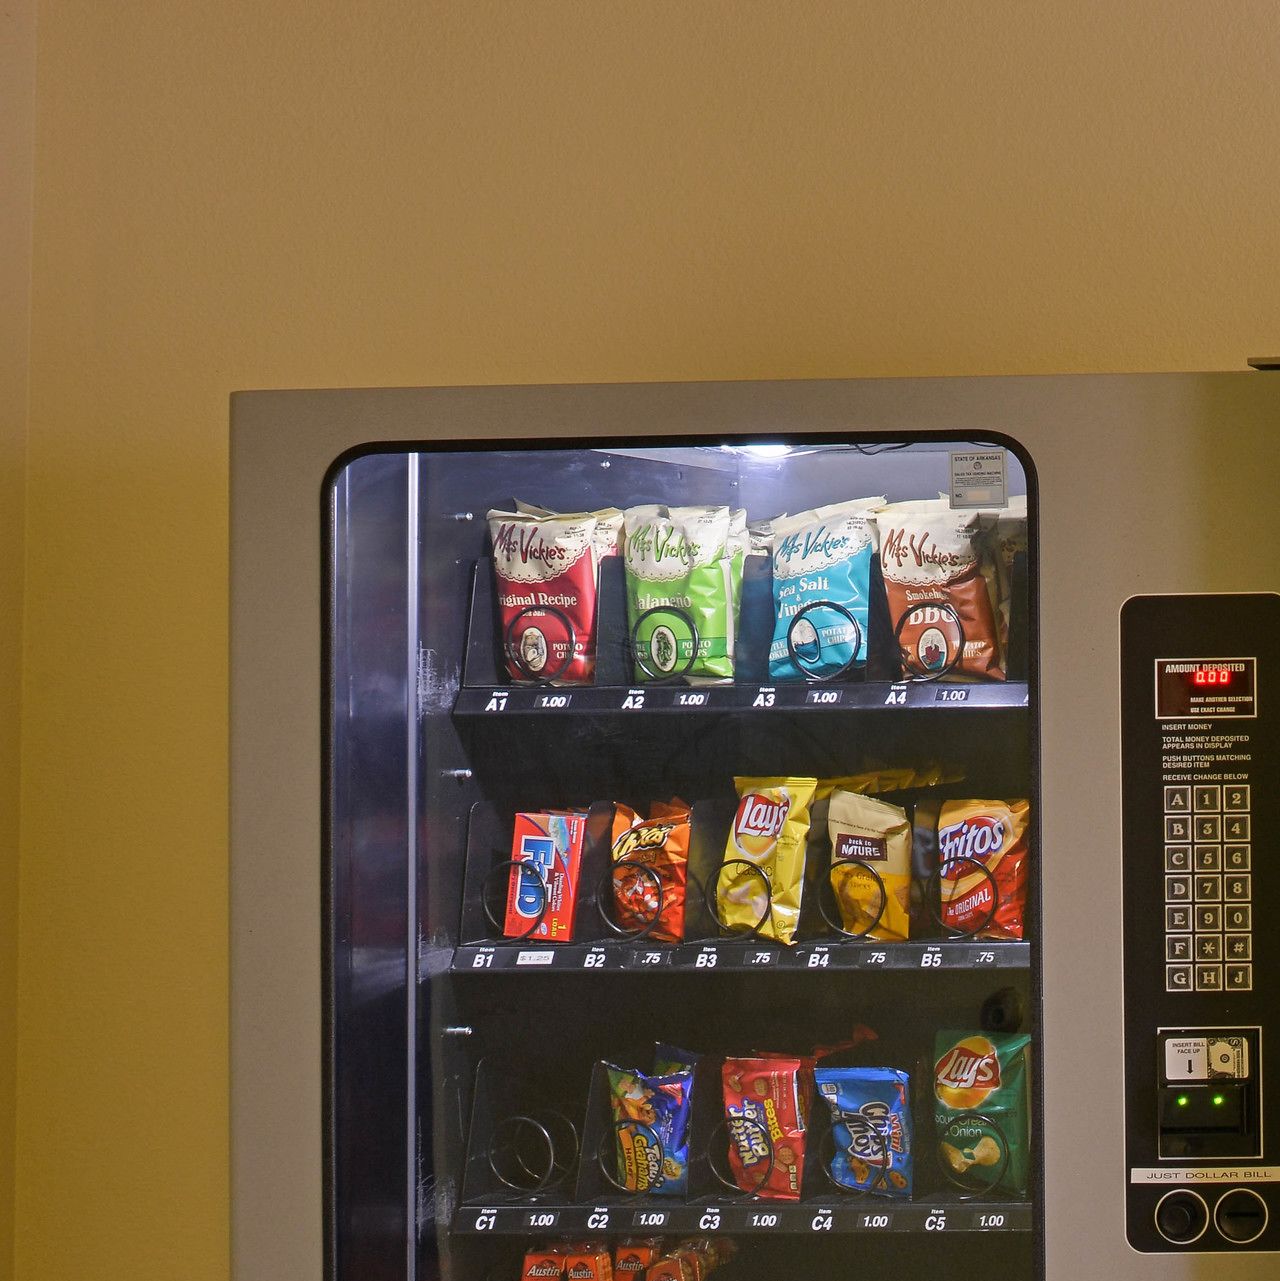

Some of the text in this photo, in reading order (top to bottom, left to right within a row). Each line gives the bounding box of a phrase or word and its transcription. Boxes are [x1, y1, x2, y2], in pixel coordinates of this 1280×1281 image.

[520, 527, 566, 567] Vickie's
[802, 526, 850, 563] Vickie's
[910, 532, 960, 573] Vickie's
[799, 577, 829, 592] Salt
[1165, 663, 1245, 674] AMOUNT DEPOSITED
[622, 693, 644, 709] A2
[680, 695, 704, 705] 1.00
[753, 691, 775, 706] A3
[813, 692, 837, 702] 1.00
[885, 690, 906, 704] A4
[941, 689, 966, 701] 1.00
[485, 695, 508, 711] A1
[542, 697, 566, 707] 1.00
[940, 821, 1004, 877] Fritos
[955, 888, 991, 915] ORIGINAL
[472, 954, 493, 967] B1
[584, 954, 605, 967] B2
[642, 953, 661, 963] .75
[696, 954, 717, 967] B3
[752, 953, 770, 963] .75
[808, 954, 829, 967] B4
[867, 953, 886, 963] .75
[921, 954, 942, 967] B5
[976, 952, 994, 962] .75
[764, 1099, 784, 1142] Bites
[951, 1125, 983, 1137] Onion
[476, 1216, 495, 1230] C1
[530, 1215, 554, 1226] 1.00
[588, 1214, 608, 1228] C2
[640, 1214, 664, 1225] 1.00
[527, 1265, 560, 1277] Austin
[568, 1268, 594, 1279] Austin
